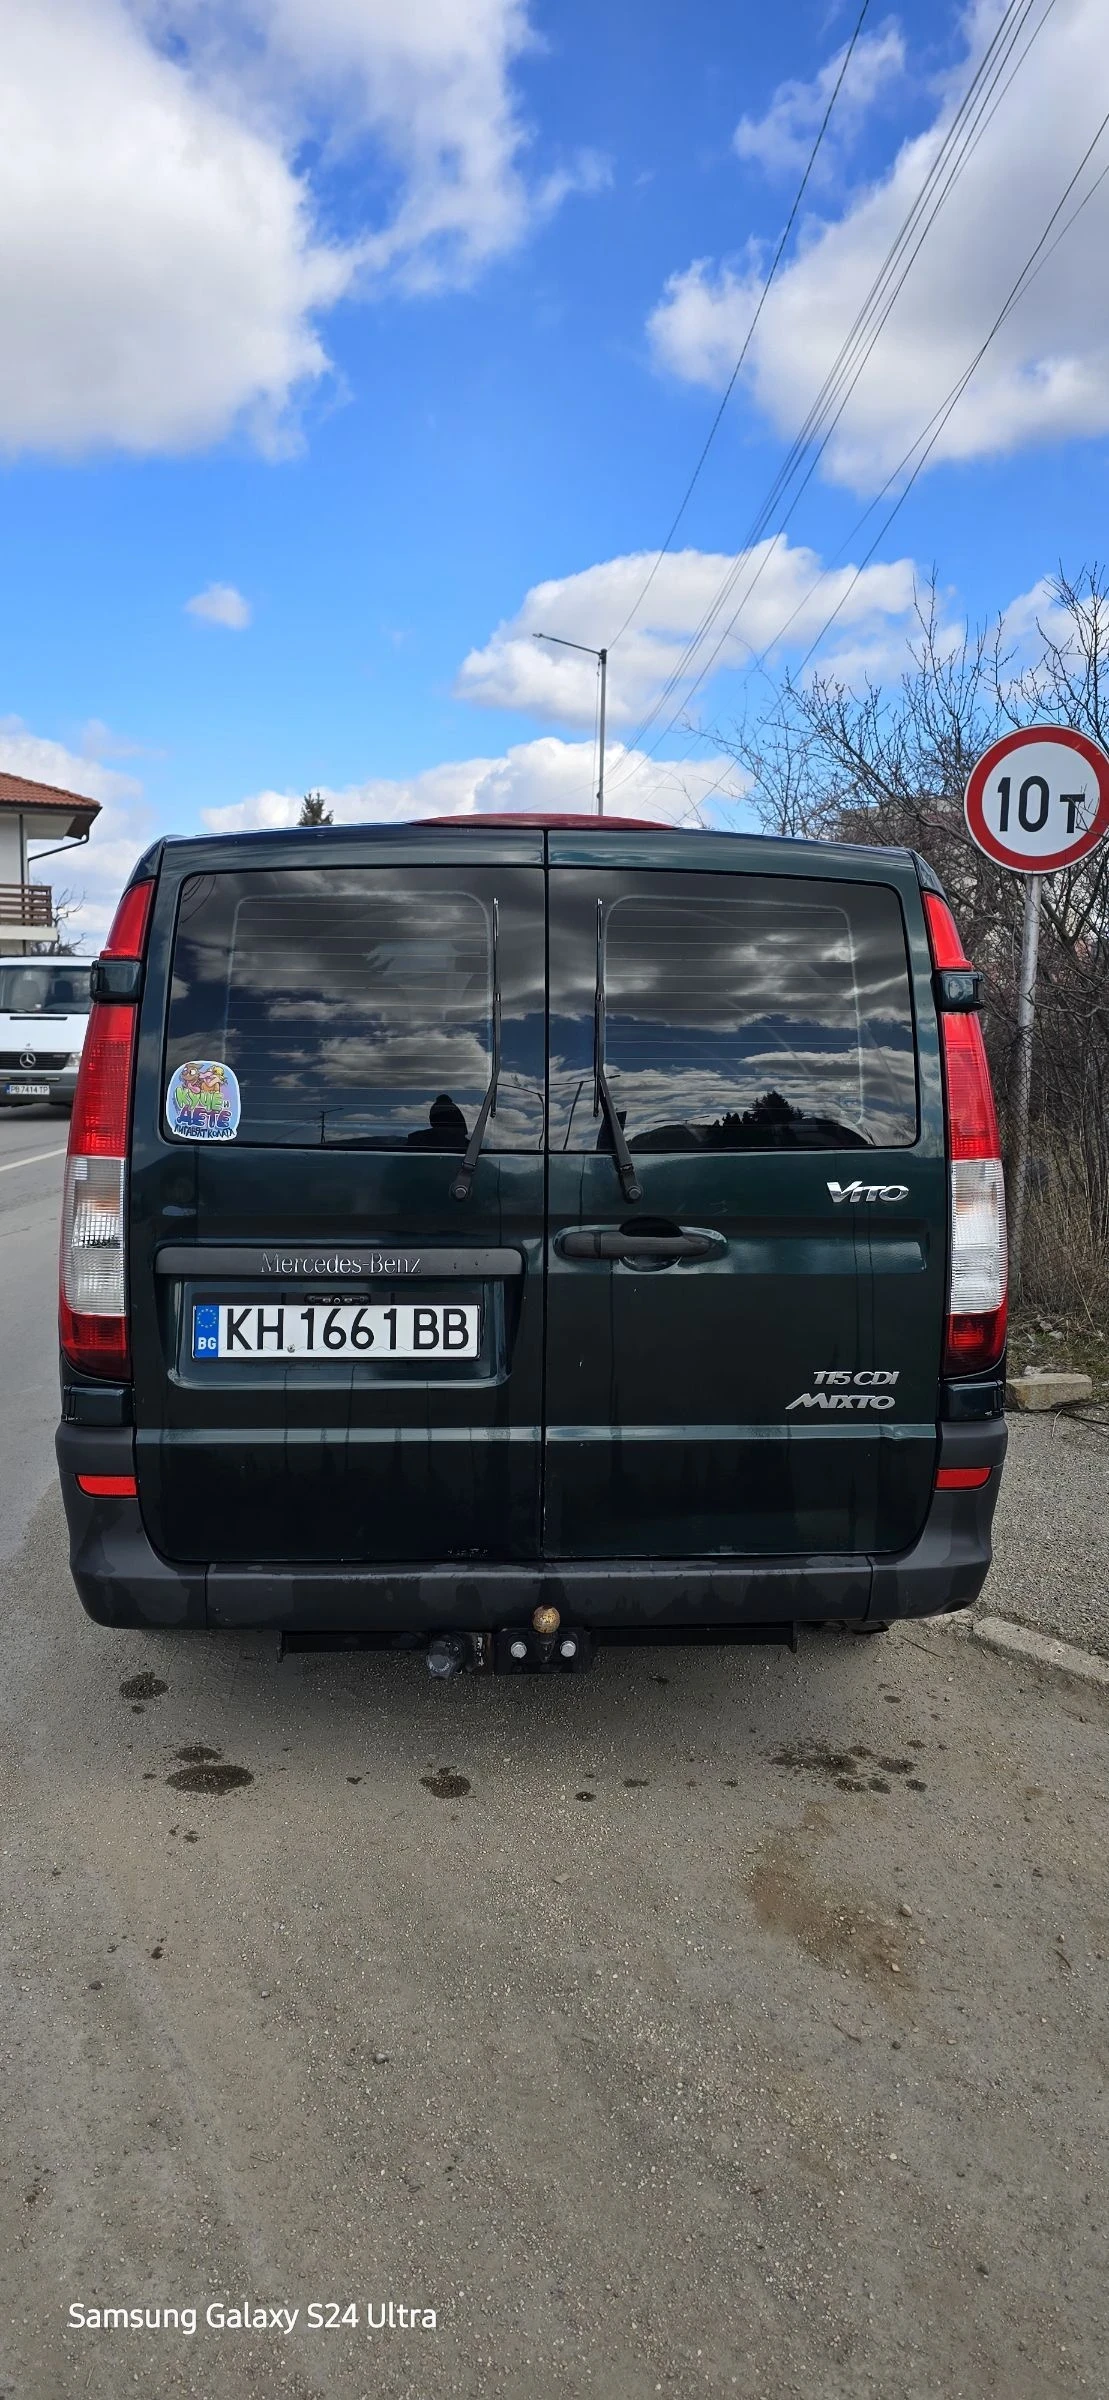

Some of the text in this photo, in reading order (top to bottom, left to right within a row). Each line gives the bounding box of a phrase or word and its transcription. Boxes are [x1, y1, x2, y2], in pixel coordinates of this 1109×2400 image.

[997, 775, 1050, 832] 10
[176, 1087, 223, 1111] КУЧЕ
[176, 1105, 232, 1128] ДЕТЕ
[260, 1252, 422, 1274] Mercedes-Benz
[227, 1308, 470, 1350] KH 1661 BB
[198, 1336, 217, 1350] BG
[813, 1370, 900, 1385] 115 CDI
[785, 1392, 896, 1410] MIXTO
